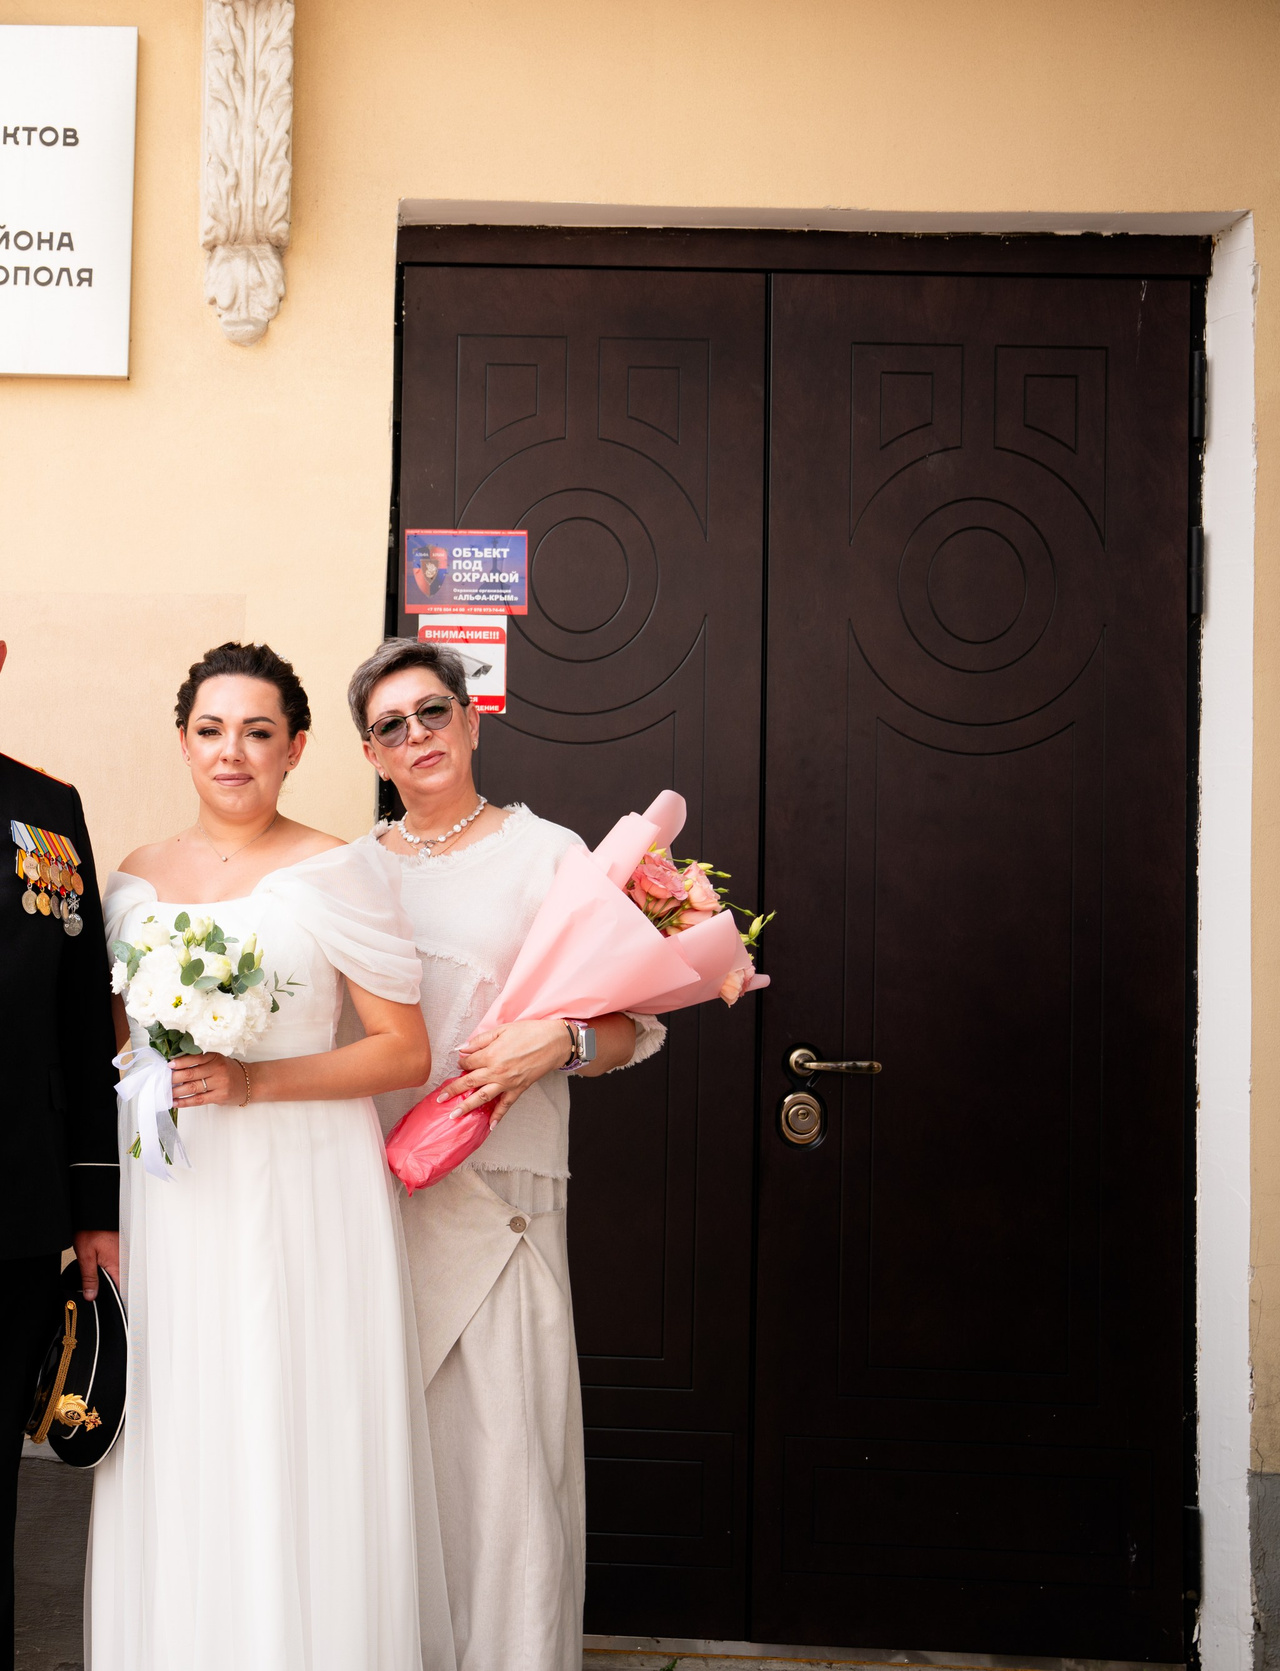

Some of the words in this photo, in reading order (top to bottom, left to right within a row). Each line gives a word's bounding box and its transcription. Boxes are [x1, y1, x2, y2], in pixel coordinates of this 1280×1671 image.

[452, 547, 510, 558] ОБЪЕКТ
[452, 560, 482, 571] ПОД
[452, 570, 519, 583] ОХРАНОЙ
[453, 594, 519, 602] «АЛЬФА-КРЫМ»
[425, 629, 499, 640] ВНИМАНИЕ!!!
